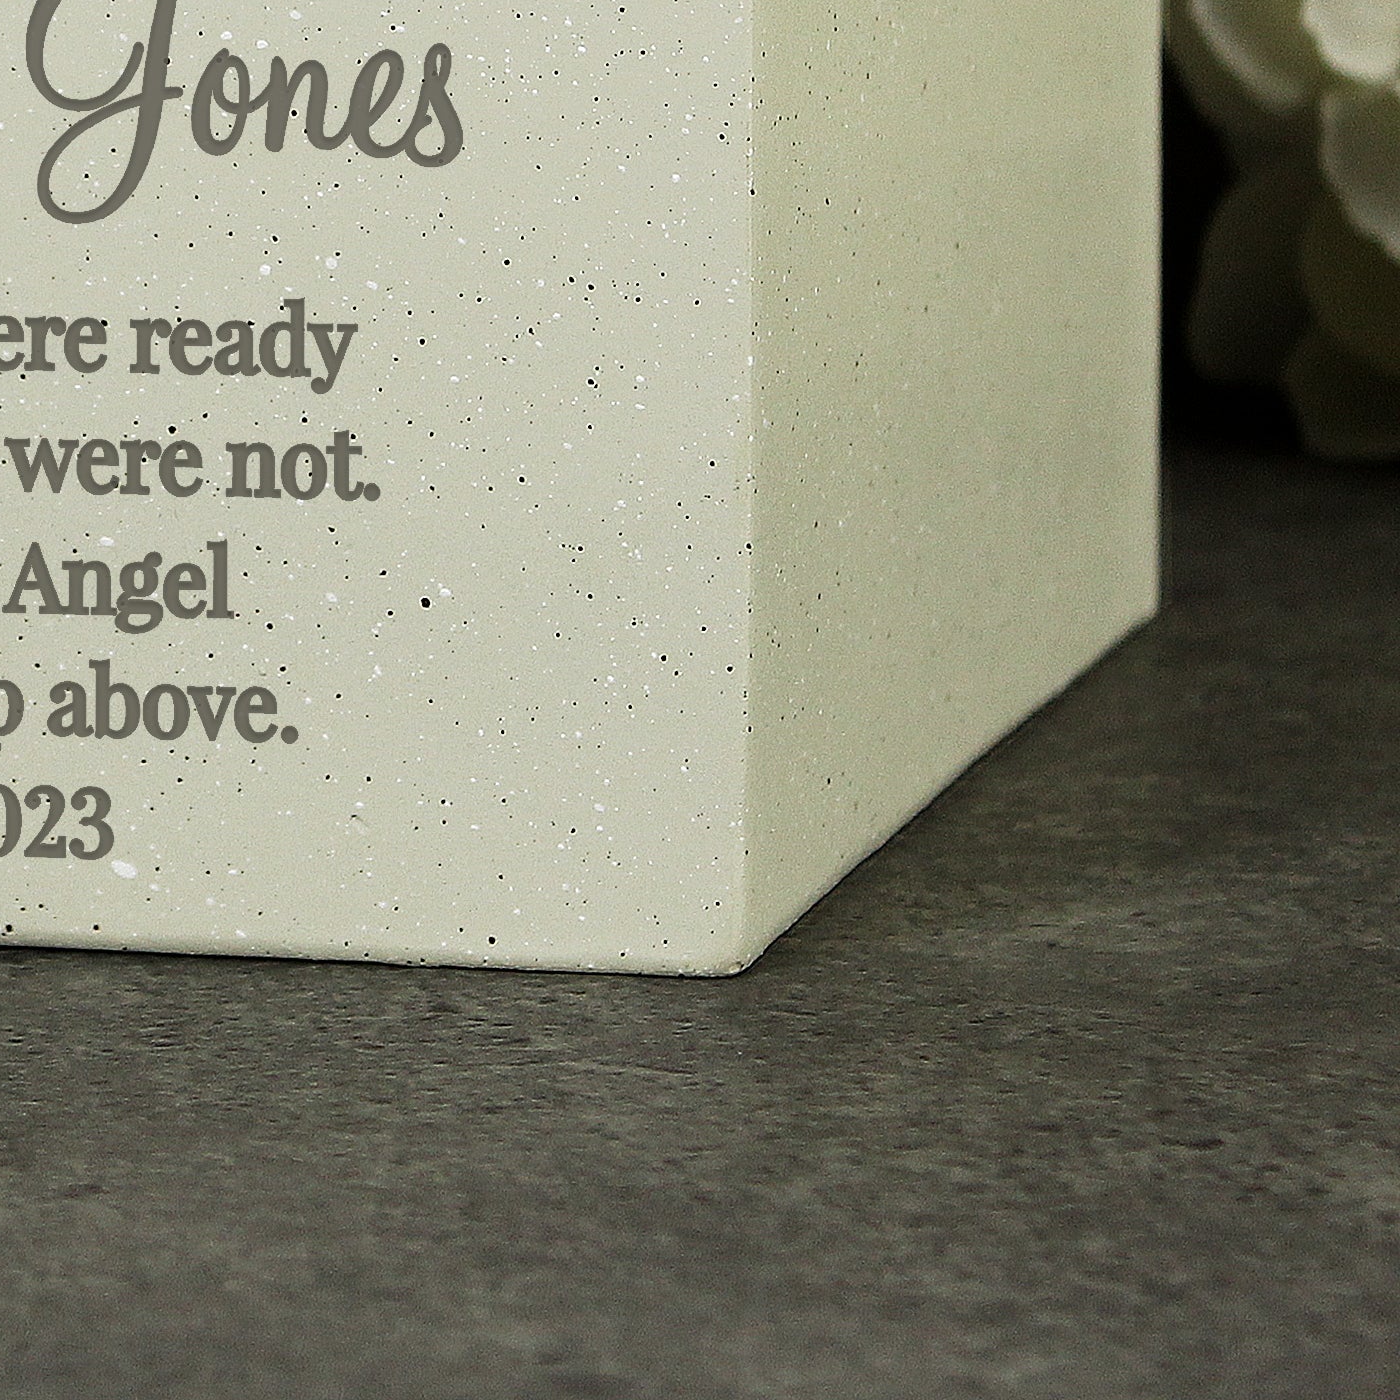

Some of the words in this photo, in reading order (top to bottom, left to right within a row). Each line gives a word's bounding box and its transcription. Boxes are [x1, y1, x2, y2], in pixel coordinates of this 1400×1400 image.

[130, 298, 358, 394] ready
[4, 437, 203, 497] were
[226, 430, 380, 501] not.
[2, 540, 235, 634] Angel
[47, 659, 298, 744] above.
